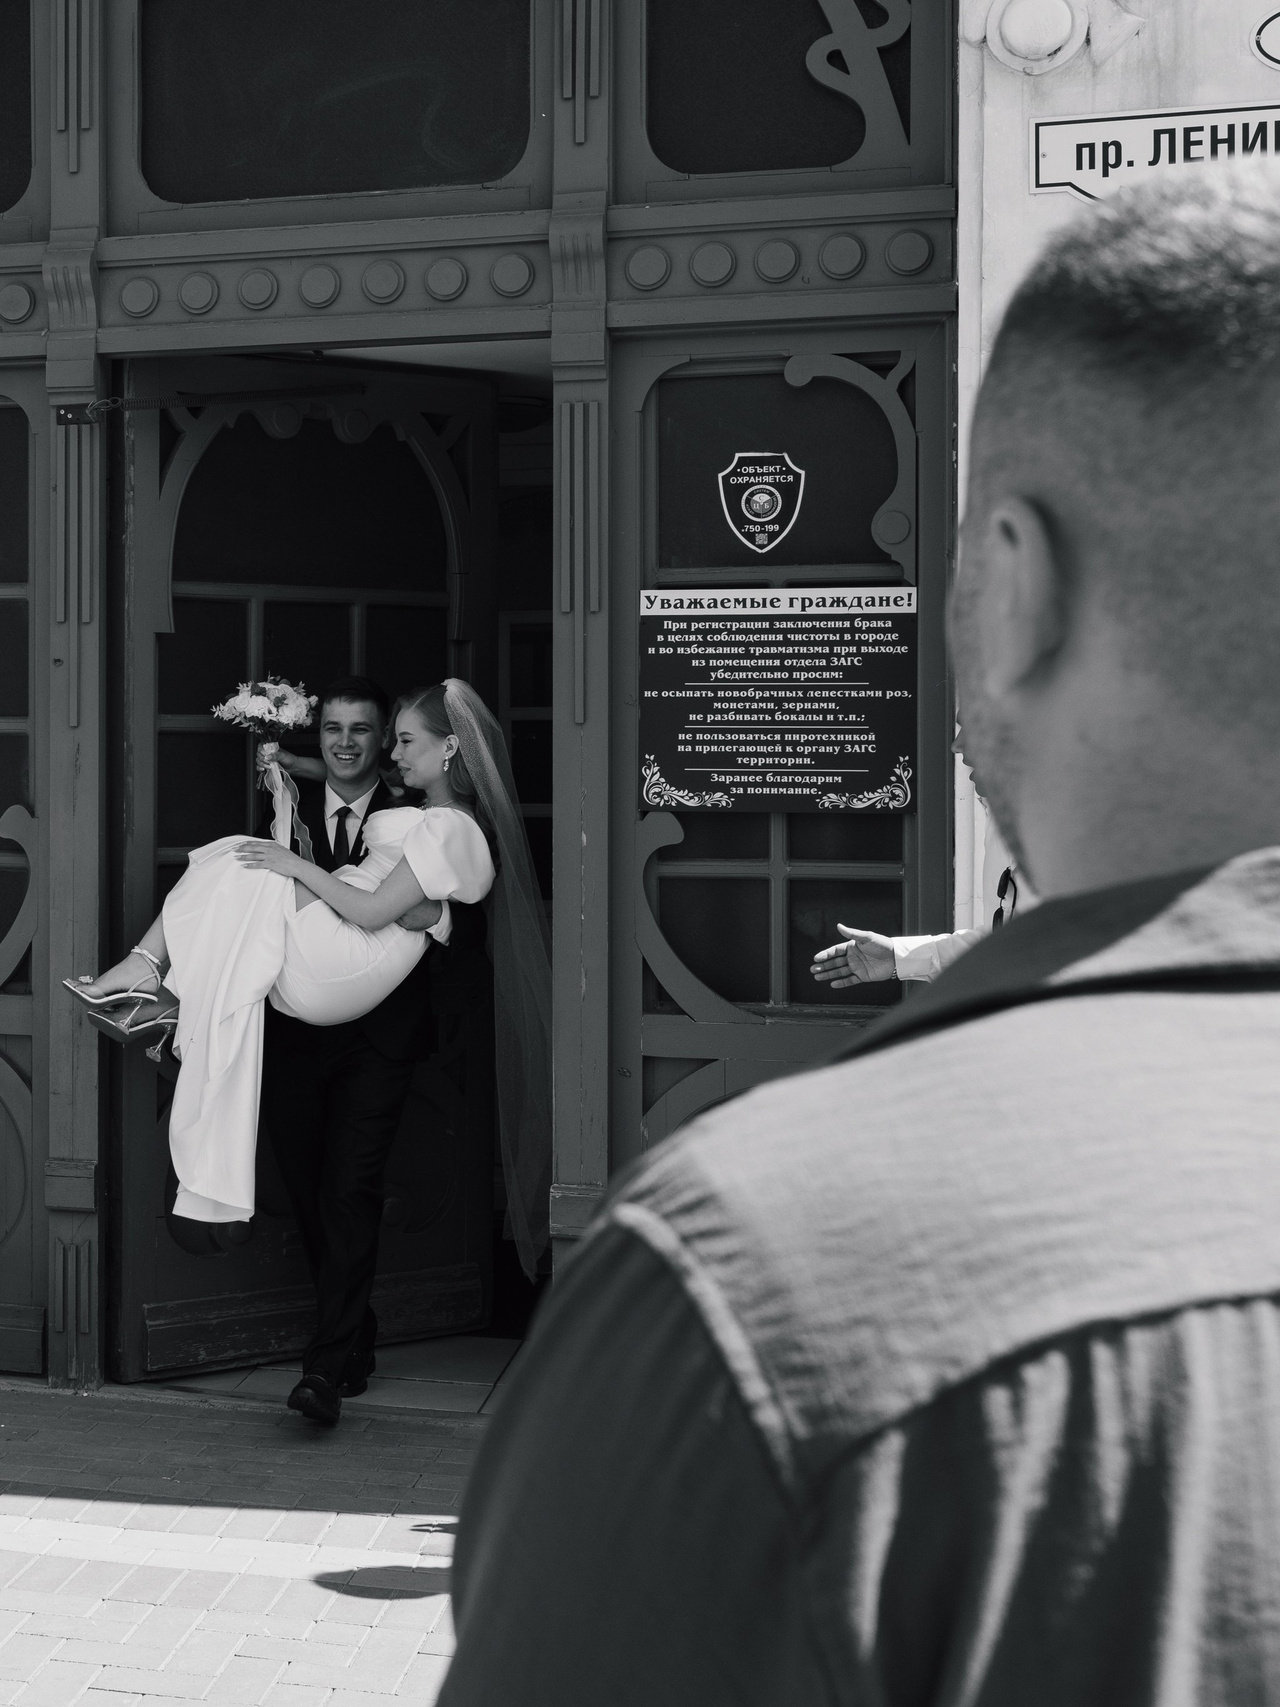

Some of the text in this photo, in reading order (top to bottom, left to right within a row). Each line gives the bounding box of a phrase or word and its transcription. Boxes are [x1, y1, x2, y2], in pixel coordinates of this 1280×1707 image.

[1075, 120, 1280, 178] пр. ЛЕНИ
[741, 465, 782, 474] ОБЪЕКТ
[729, 474, 794, 485] ОХРАНЯЕТСЯ
[643, 592, 913, 613] Уважаемые граждане!
[663, 617, 892, 632] При регистрации заключения брака
[656, 631, 899, 643] в целях соблюдения чистоты в городе
[658, 647, 674, 655] во
[676, 643, 746, 655] избежание
[748, 646, 830, 656] травматизма
[833, 646, 857, 656] при
[860, 645, 909, 654] выходе
[691, 656, 863, 668] из помещения отдела ЗАГС
[710, 668, 843, 681] убедительно просим:
[644, 687, 912, 700] не осыпать новобрачных лепестками роз,
[713, 702, 840, 712] монетами, зернами,
[689, 713, 704, 721] не
[706, 711, 772, 723] разбивать
[774, 711, 823, 721] бокалы
[837, 714, 865, 722] т.п.;
[678, 732, 876, 743] не пользоваться пиротехникой
[695, 743, 782, 754] прилегающей
[785, 745, 794, 753] к
[796, 745, 841, 755] органу
[843, 744, 877, 753] ЗАГС
[736, 757, 815, 767] территории.
[710, 772, 842, 785] Заранее благодарим
[729, 786, 822, 795] за понимание.
